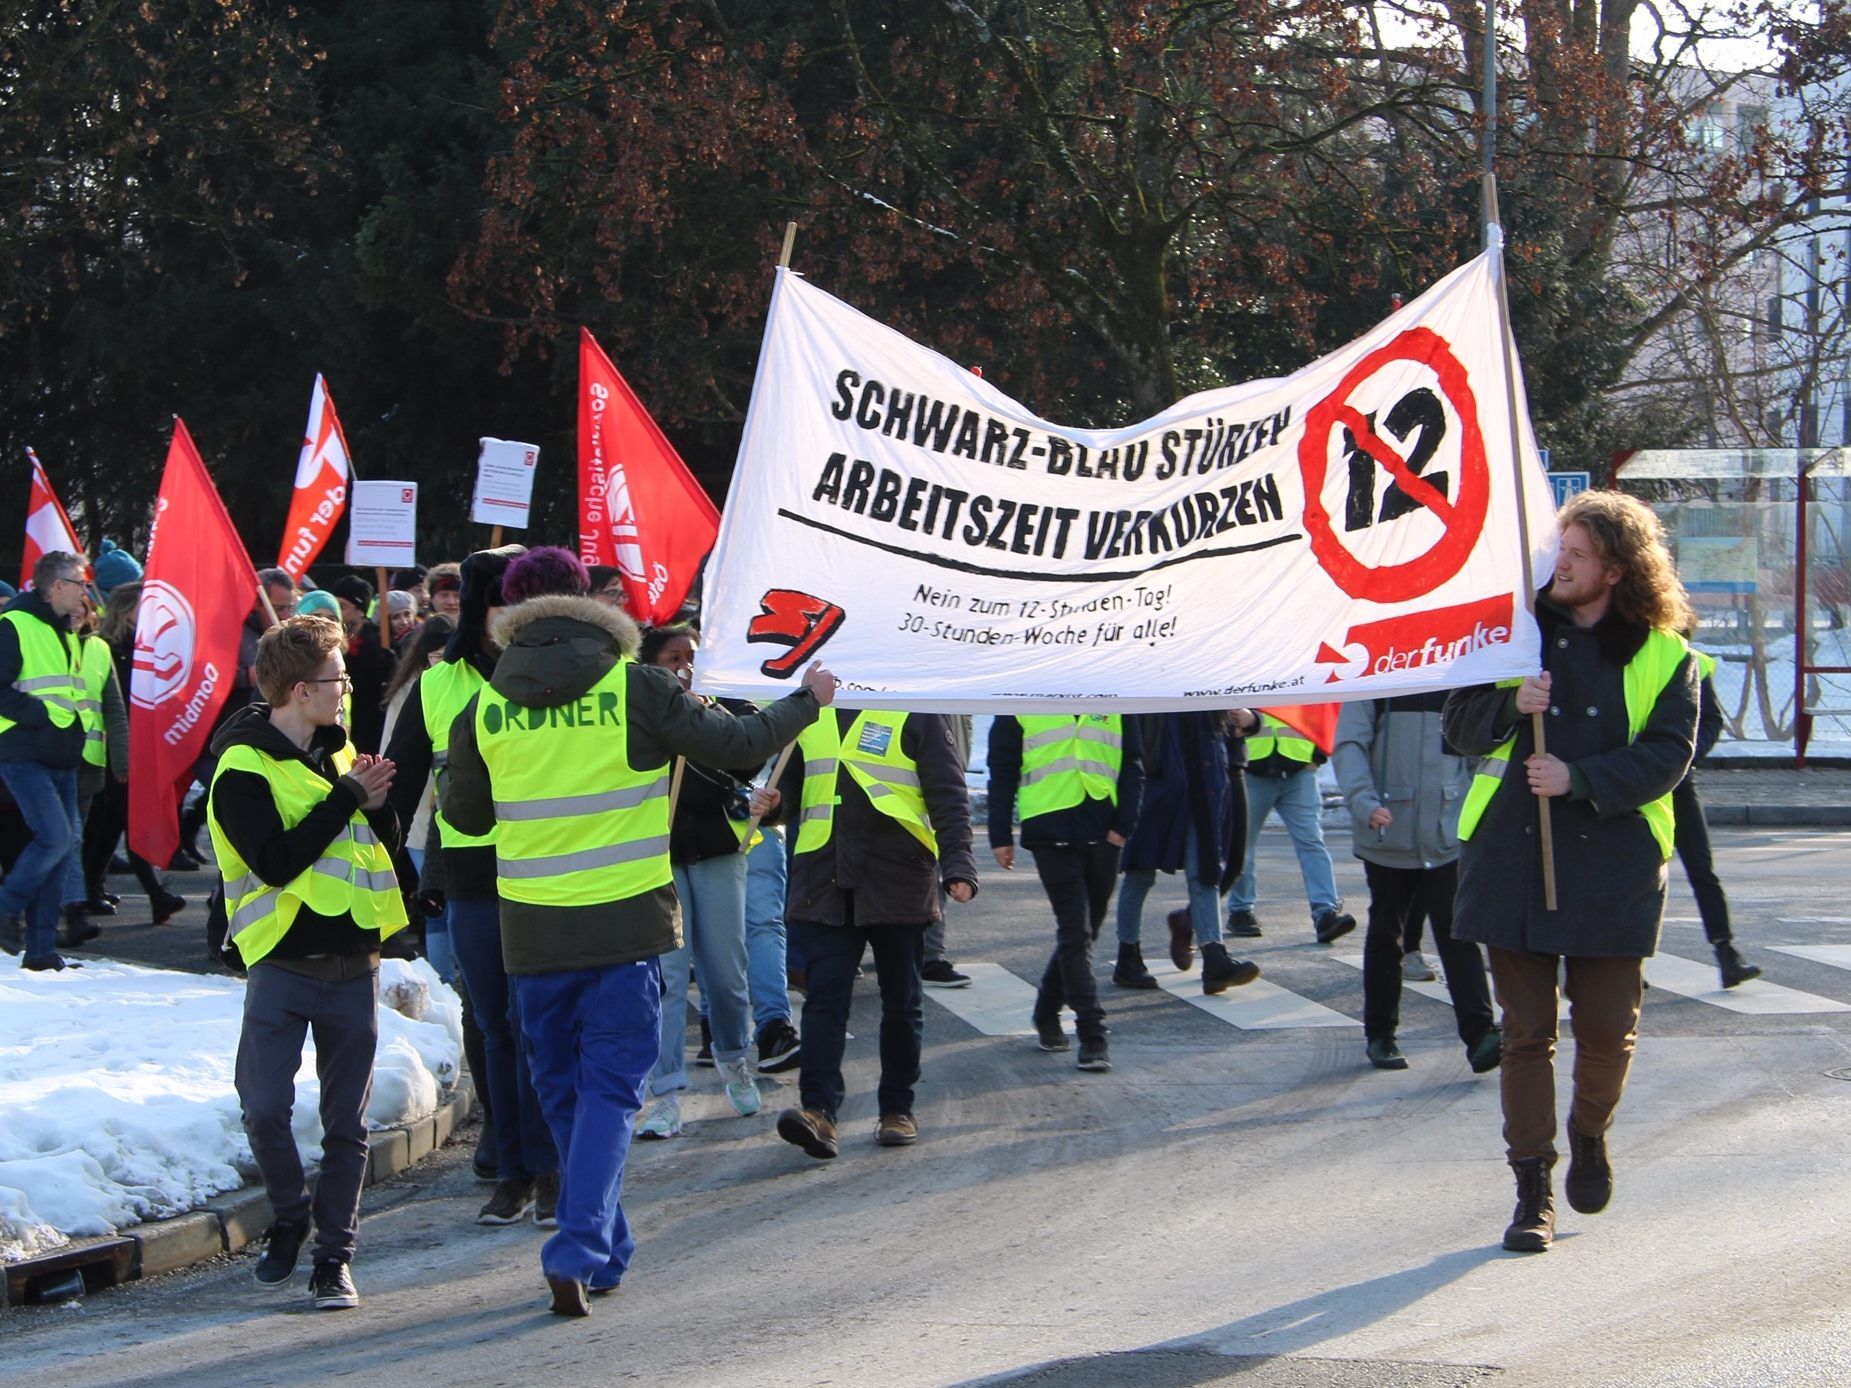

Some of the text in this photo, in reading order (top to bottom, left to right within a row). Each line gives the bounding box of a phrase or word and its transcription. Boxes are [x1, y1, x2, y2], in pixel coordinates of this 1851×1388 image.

[832, 369, 1148, 482] SCHWARZ-BLAU
[1343, 387, 1448, 532] 12
[812, 452, 1080, 560] ARBEITSZEIT
[913, 584, 960, 609] Nein
[968, 596, 1010, 617] zum
[898, 612, 1177, 647] 30-Stunden-Woche für alle!
[1183, 675, 1305, 697] www.derfunke.at
[486, 692, 620, 735] ORDNER
